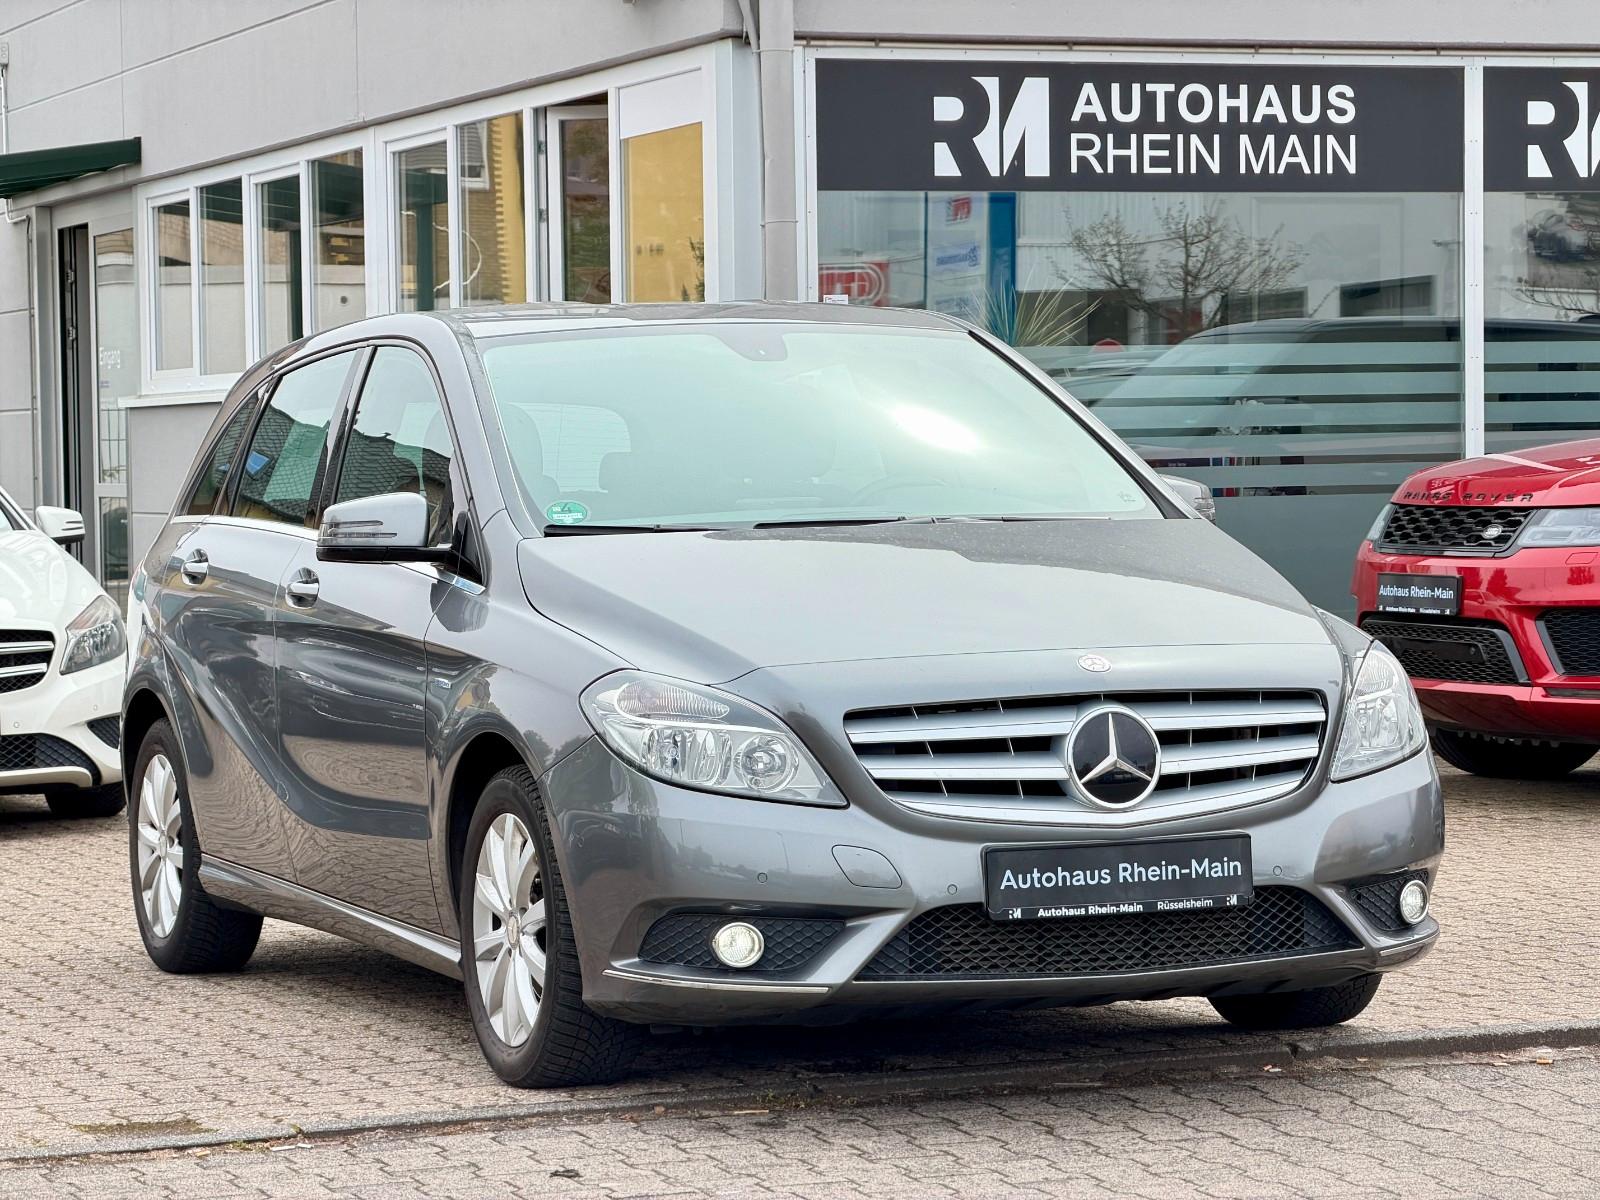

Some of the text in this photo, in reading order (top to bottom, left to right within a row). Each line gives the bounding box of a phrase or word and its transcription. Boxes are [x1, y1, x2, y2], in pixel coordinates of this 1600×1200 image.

[1070, 82, 1357, 124] AUTOHAUS
[1071, 132, 1357, 175] RHEIN MAIN
[1403, 491, 1534, 502] RANGE ROVER
[1378, 584, 1454, 599] Autohaus Rhein-Main
[1000, 857, 1242, 889] Autohaus Rhein-Main
[1037, 905, 1085, 918] Autohaus
[1088, 902, 1143, 915] Rhein-Main
[1157, 898, 1213, 911] Rüsselsheim
